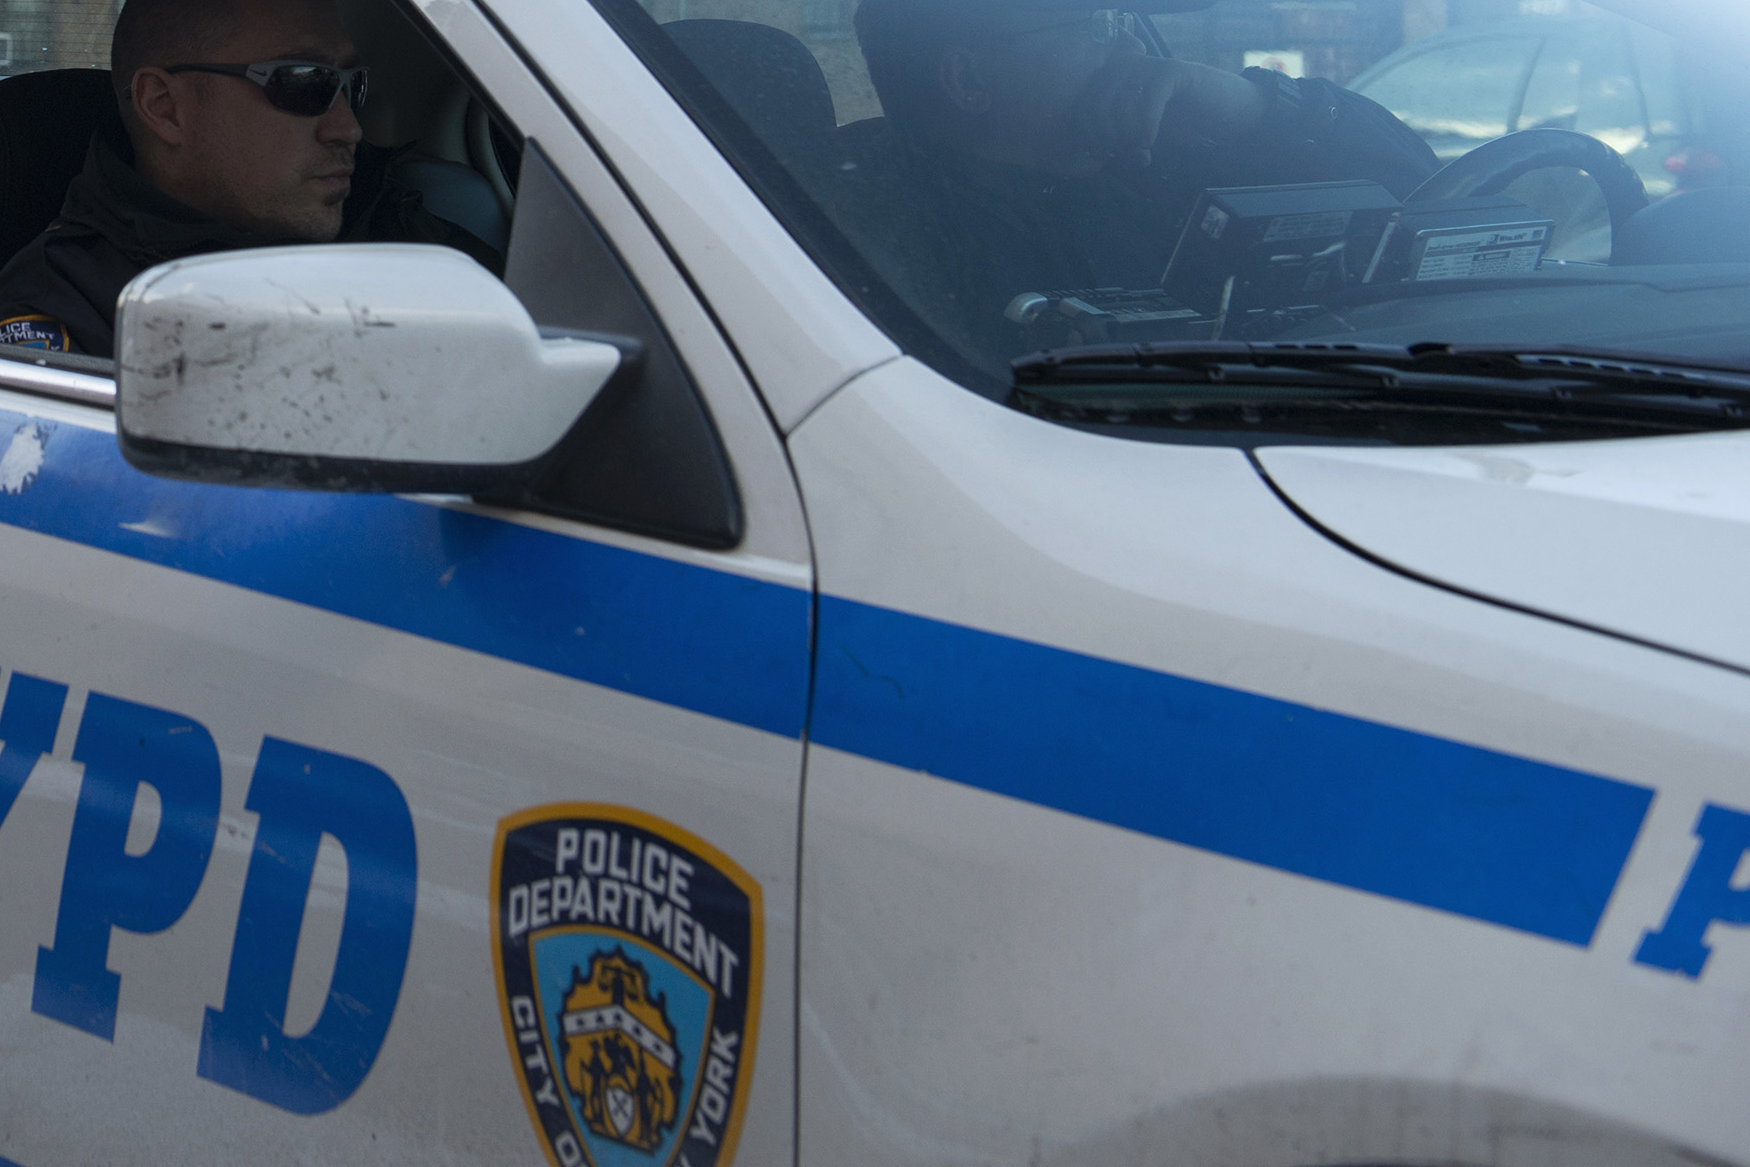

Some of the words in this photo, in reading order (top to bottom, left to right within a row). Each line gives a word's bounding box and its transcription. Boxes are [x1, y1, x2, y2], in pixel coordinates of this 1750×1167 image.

[555, 827, 694, 912] POLICE
[508, 876, 739, 999] DEPARTMENT
[511, 996, 561, 1108] CITY
[555, 1131, 588, 1167] O
[690, 1026, 738, 1147] YORK
